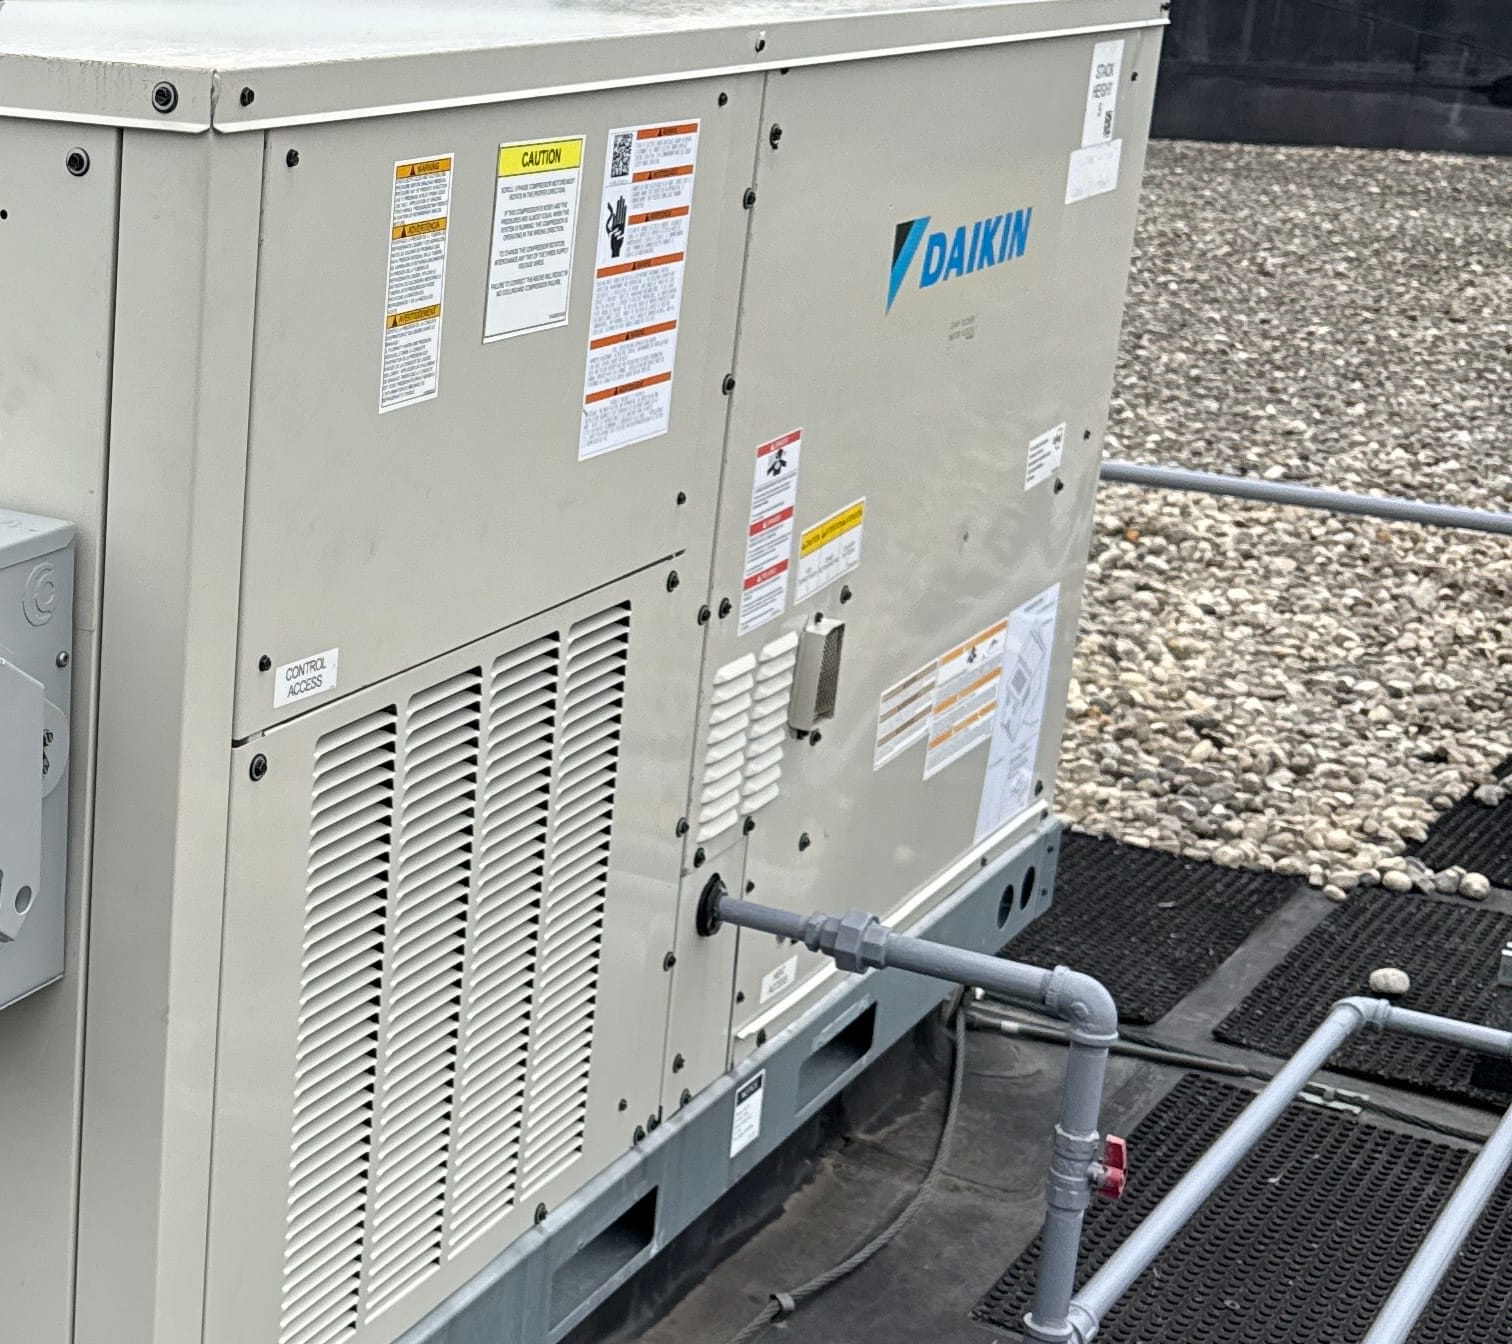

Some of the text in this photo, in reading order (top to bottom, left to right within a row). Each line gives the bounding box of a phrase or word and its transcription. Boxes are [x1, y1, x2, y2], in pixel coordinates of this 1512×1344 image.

[521, 148, 562, 167] CAUTION
[920, 207, 1033, 289] DAIKIN
[286, 656, 327, 681] CONTROL
[287, 674, 323, 698] ACCESS
